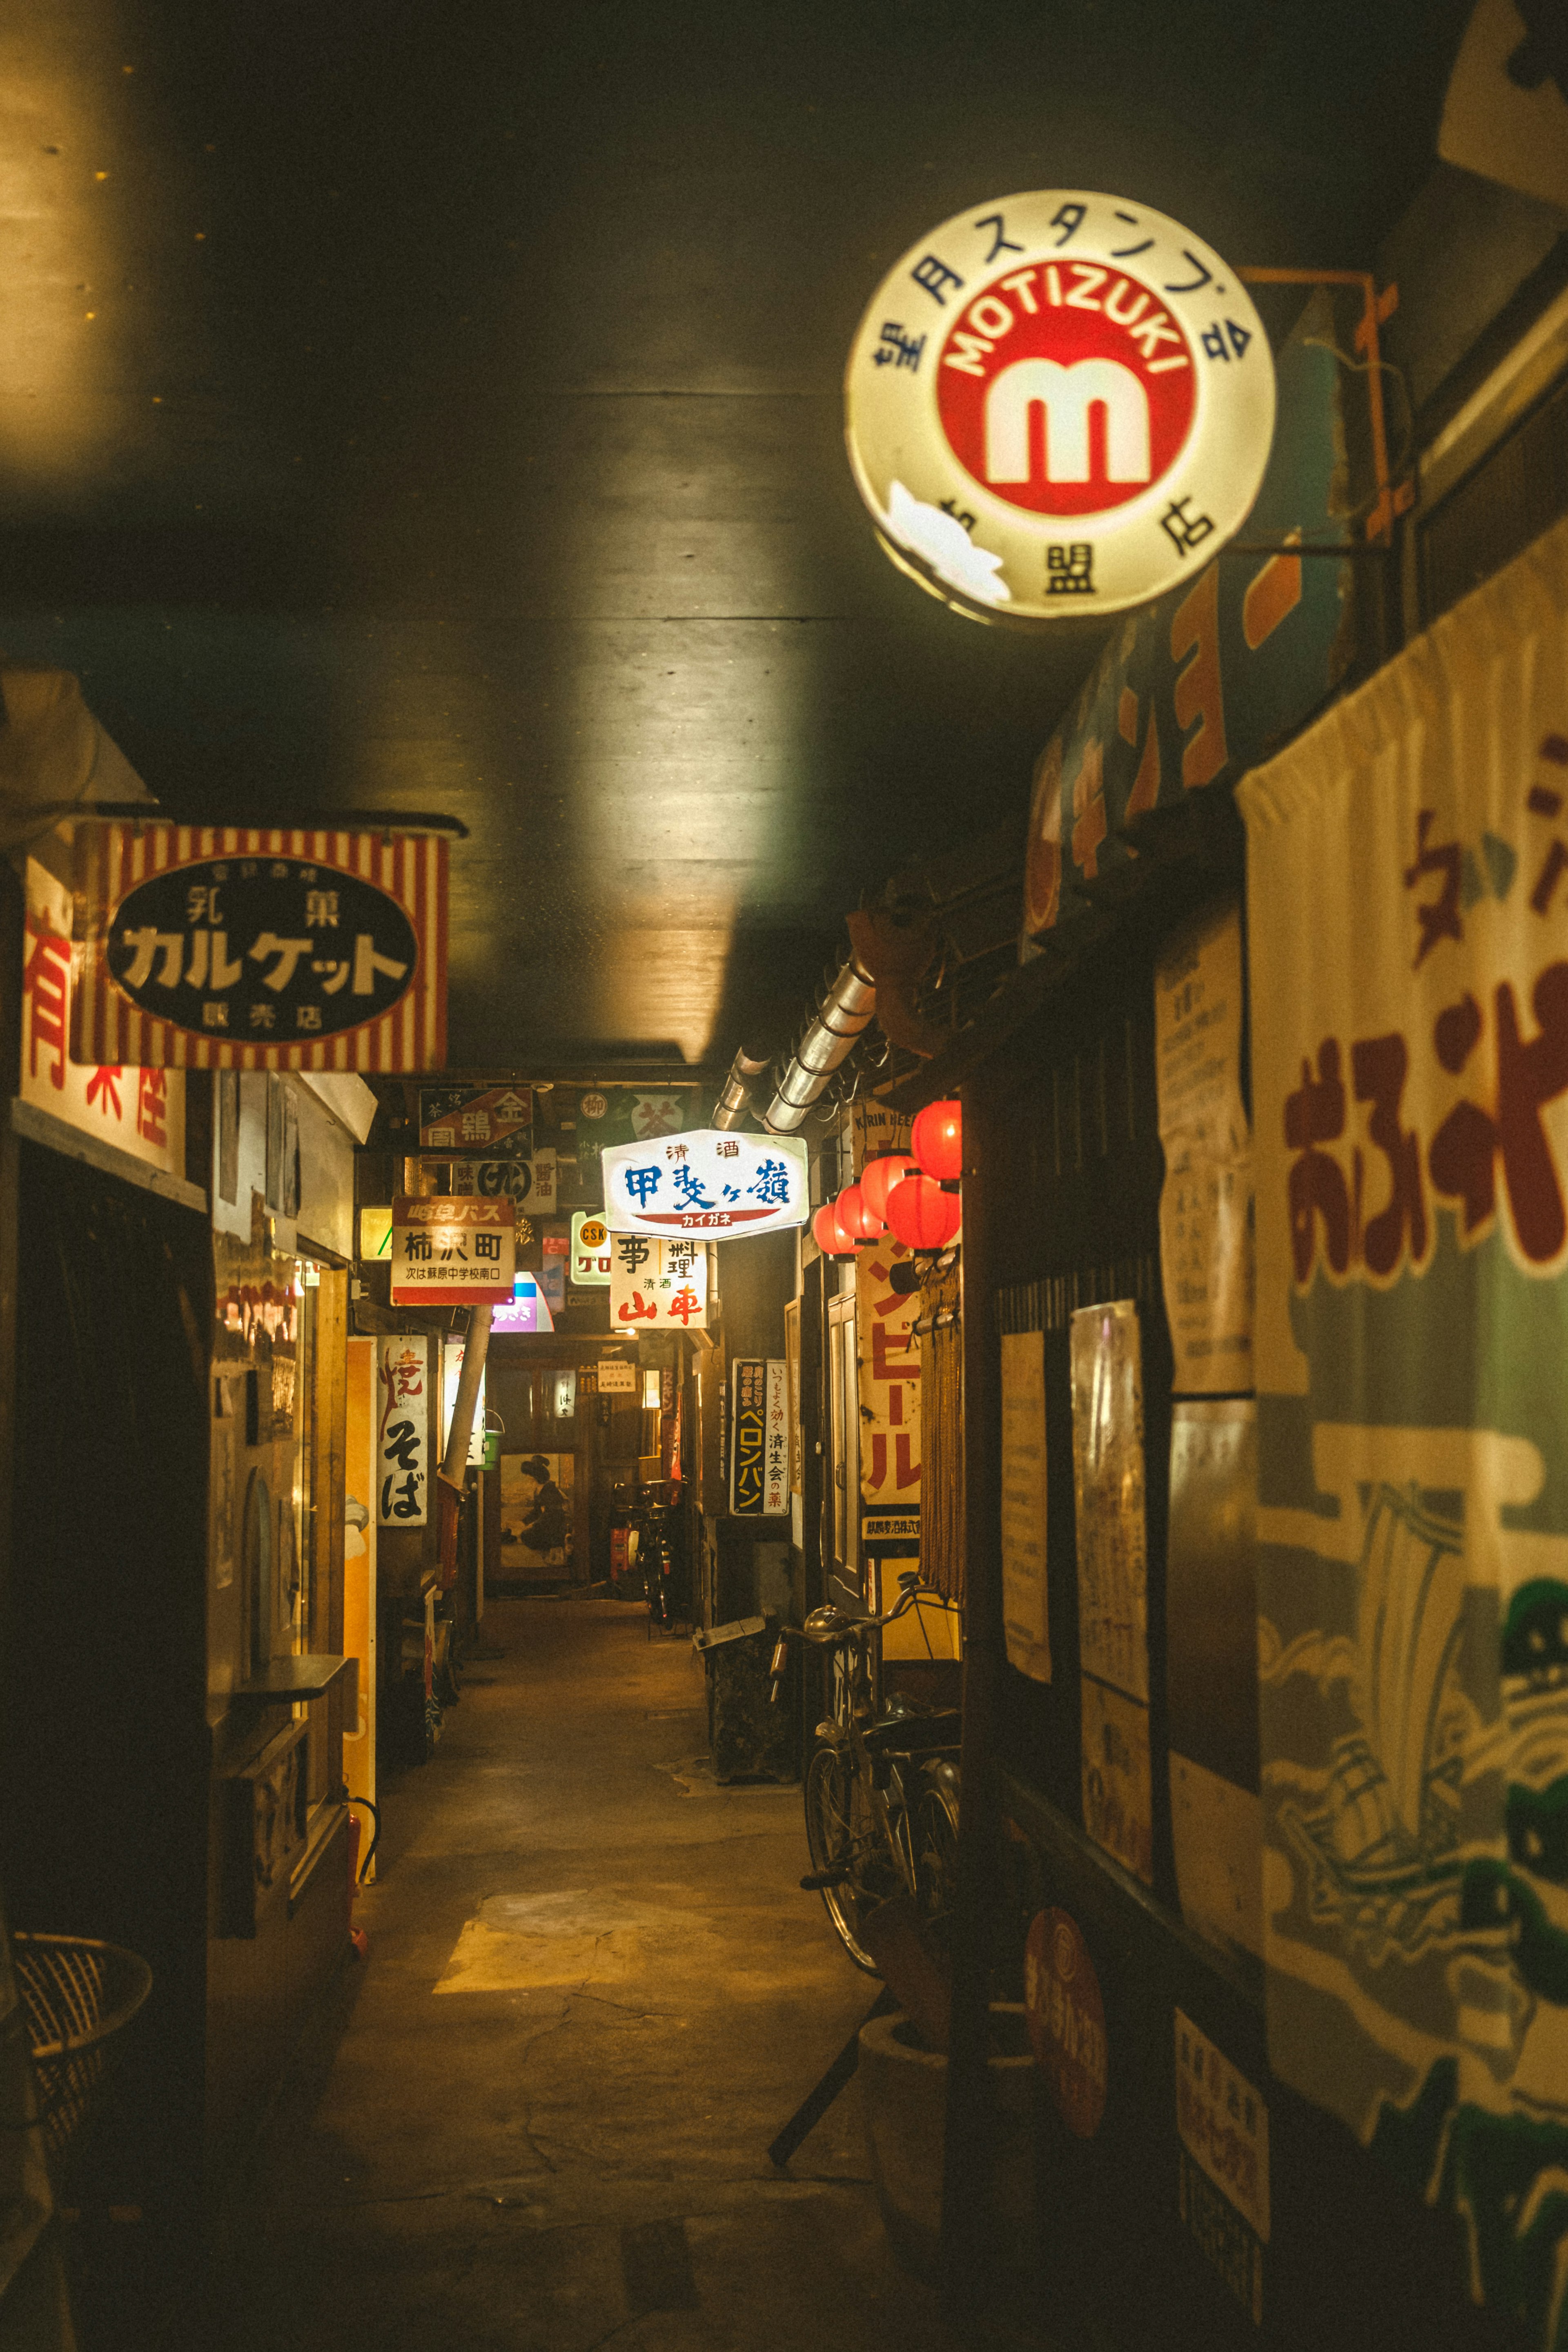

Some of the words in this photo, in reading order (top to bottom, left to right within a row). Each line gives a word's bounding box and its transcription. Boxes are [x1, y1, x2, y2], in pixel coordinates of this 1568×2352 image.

[944, 265, 1189, 376] MOTIZUKI
[123, 926, 407, 996] カルケット
[855, 1112, 886, 1131] KRIN
[666, 1140, 740, 1164] 清酒
[407, 1204, 501, 1221] 岐阜バス
[682, 1213, 731, 1227] カイガネ
[582, 1228, 605, 1241] CSK
[405, 1267, 500, 1280] 次は蘇原中学校南口
[644, 1278, 671, 1290] 清酒
[618, 1283, 703, 1326] 山車
[741, 1366, 753, 1407] 腰の痛み
[754, 1366, 764, 1407] 肩のこり
[738, 1409, 764, 1508] ペロンバン
